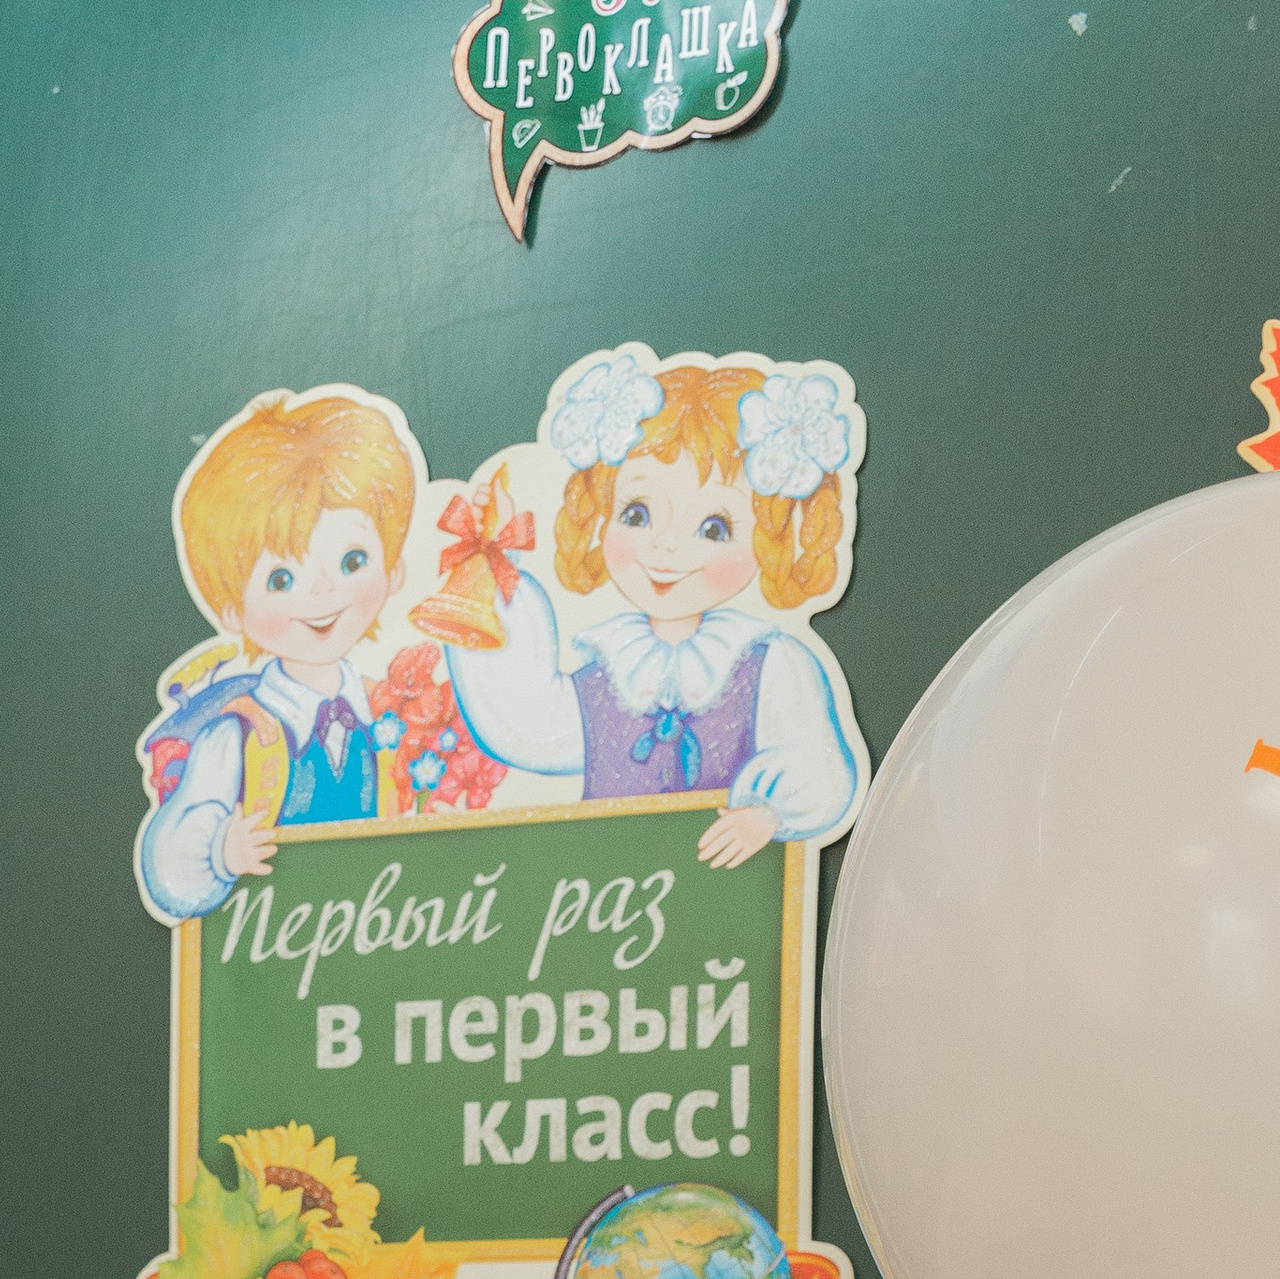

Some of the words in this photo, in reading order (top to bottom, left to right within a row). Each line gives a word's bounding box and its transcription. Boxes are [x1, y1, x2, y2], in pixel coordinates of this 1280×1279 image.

[483, 0, 759, 108] ПЕРВОКЛАШКА
[220, 862, 508, 1000] Первый
[527, 868, 676, 981] раз
[316, 1004, 364, 1069] в
[393, 956, 750, 1083] первый
[462, 1064, 751, 1166] класс!
